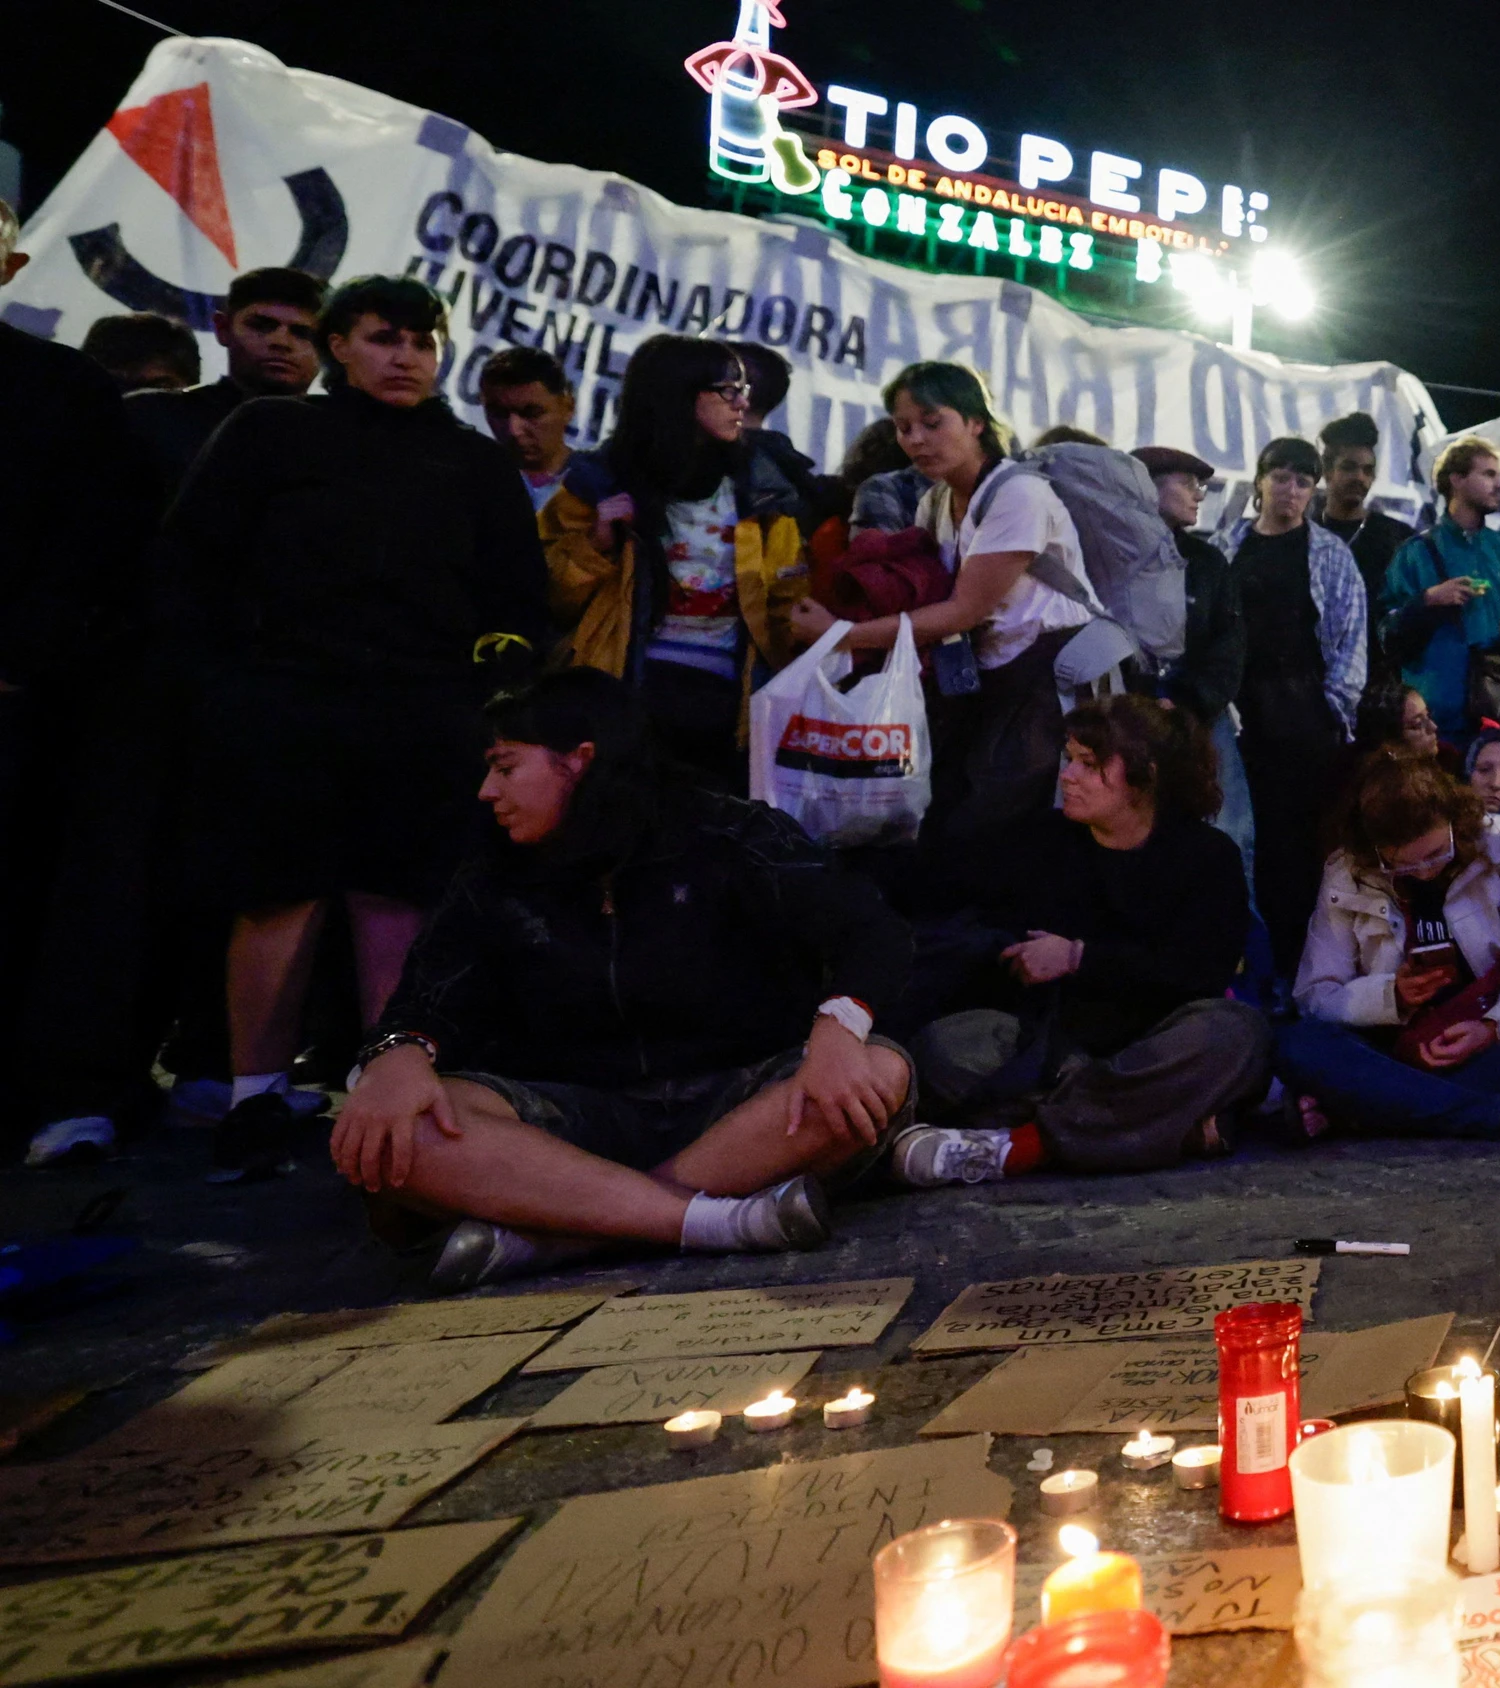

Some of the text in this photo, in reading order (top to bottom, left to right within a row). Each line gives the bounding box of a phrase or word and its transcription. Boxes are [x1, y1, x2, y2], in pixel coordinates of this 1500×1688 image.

[827, 84, 988, 172] TIO
[817, 148, 881, 181] SOL
[887, 163, 927, 192] DE
[935, 176, 1084, 226] ANDALUCIA
[821, 167, 1094, 271] GONZALEZ
[415, 189, 868, 372] COORDINADORA
[1018, 1327, 1072, 1342] un
